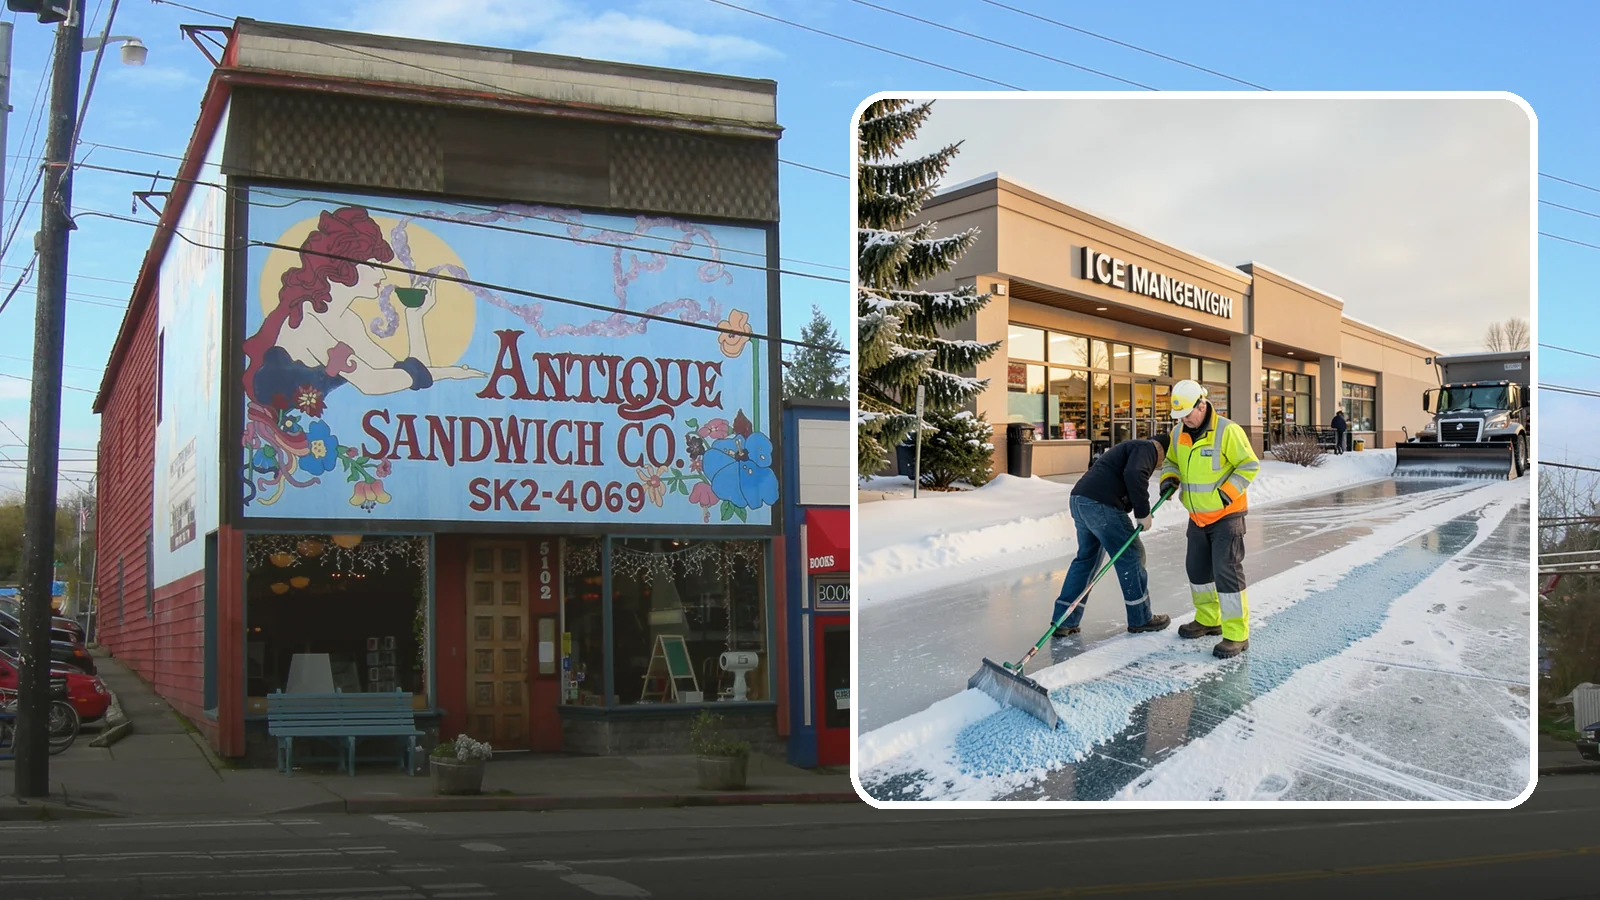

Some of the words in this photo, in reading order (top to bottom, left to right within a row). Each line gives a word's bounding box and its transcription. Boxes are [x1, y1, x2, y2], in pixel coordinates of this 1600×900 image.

[1082, 246, 1125, 288] ICE
[476, 329, 723, 420] ANTIQUE
[361, 408, 604, 467] SANDWICH
[617, 421, 685, 469] CO.
[469, 478, 646, 513] SK2-4069
[540, 542, 551, 599] 5102
[809, 555, 835, 569] BOOKS
